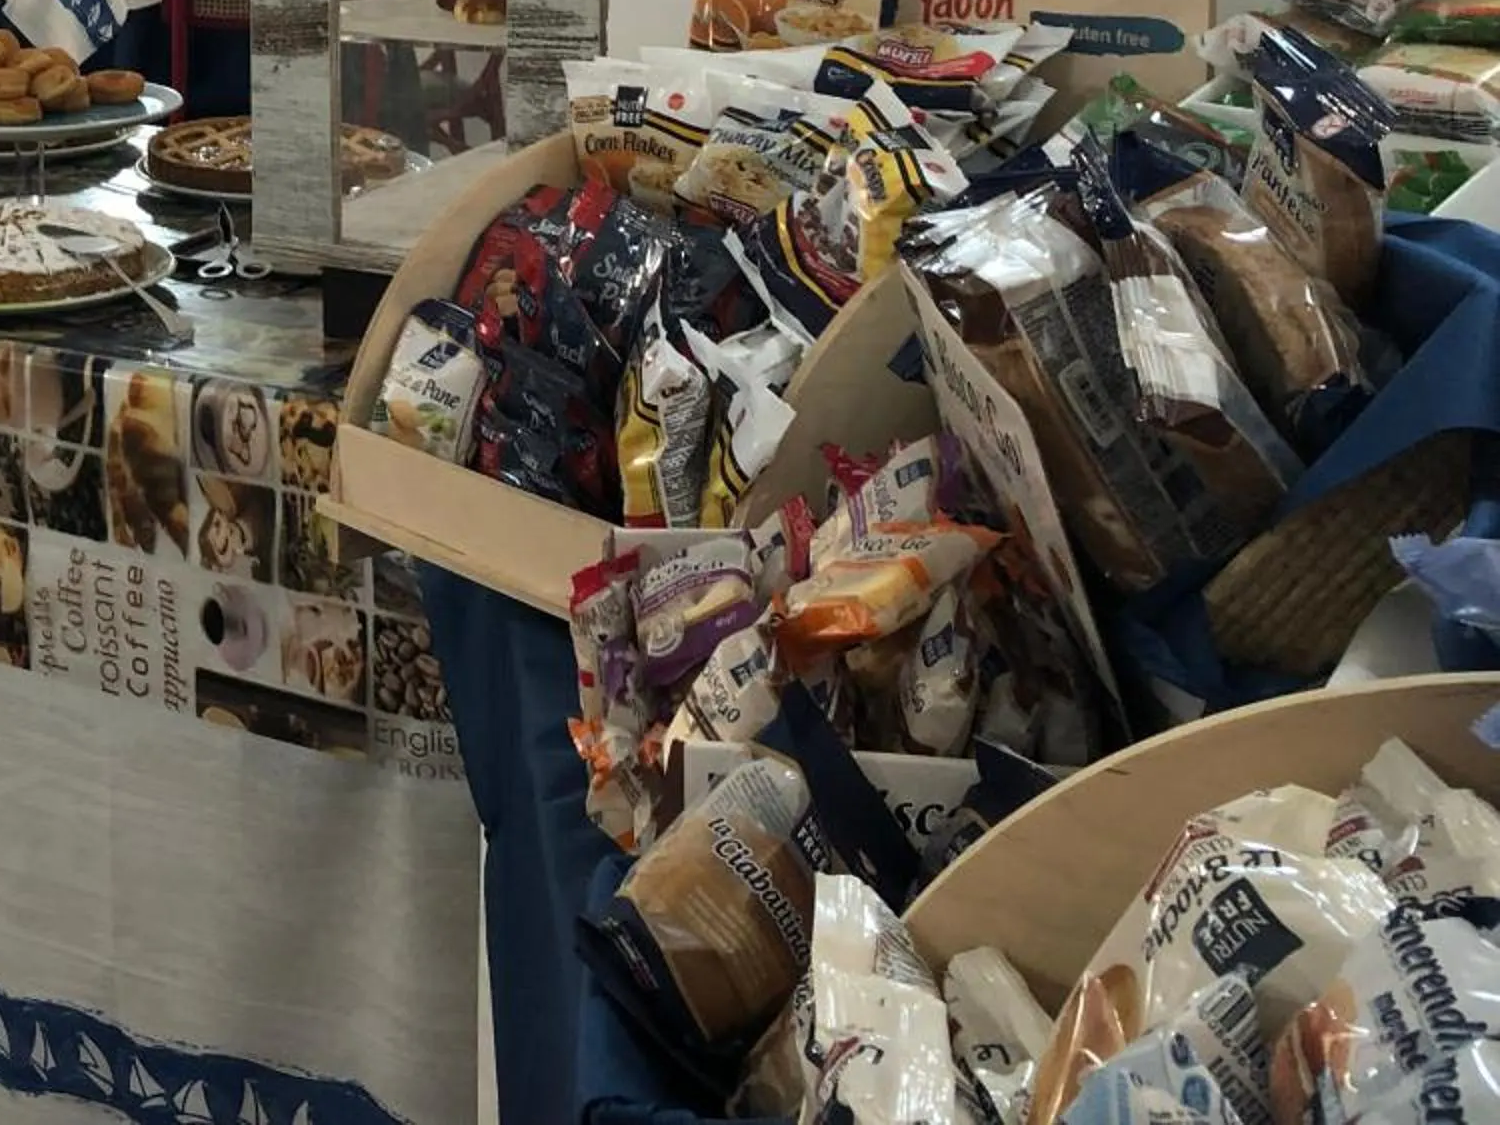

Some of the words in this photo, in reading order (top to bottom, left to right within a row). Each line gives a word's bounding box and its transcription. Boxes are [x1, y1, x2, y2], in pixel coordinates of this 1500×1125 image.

[1116, 28, 1151, 48] free
[584, 132, 619, 155] Corn
[623, 131, 677, 163] Flakes
[777, 144, 821, 175] Mix
[422, 376, 461, 409] Pane
[57, 546, 88, 655] Coffee
[122, 564, 149, 698] Coffee
[374, 718, 456, 758] Englis
[1141, 854, 1231, 963] Brioche
[1199, 889, 1253, 946] FREE
[1209, 909, 1270, 964] NUTRI
